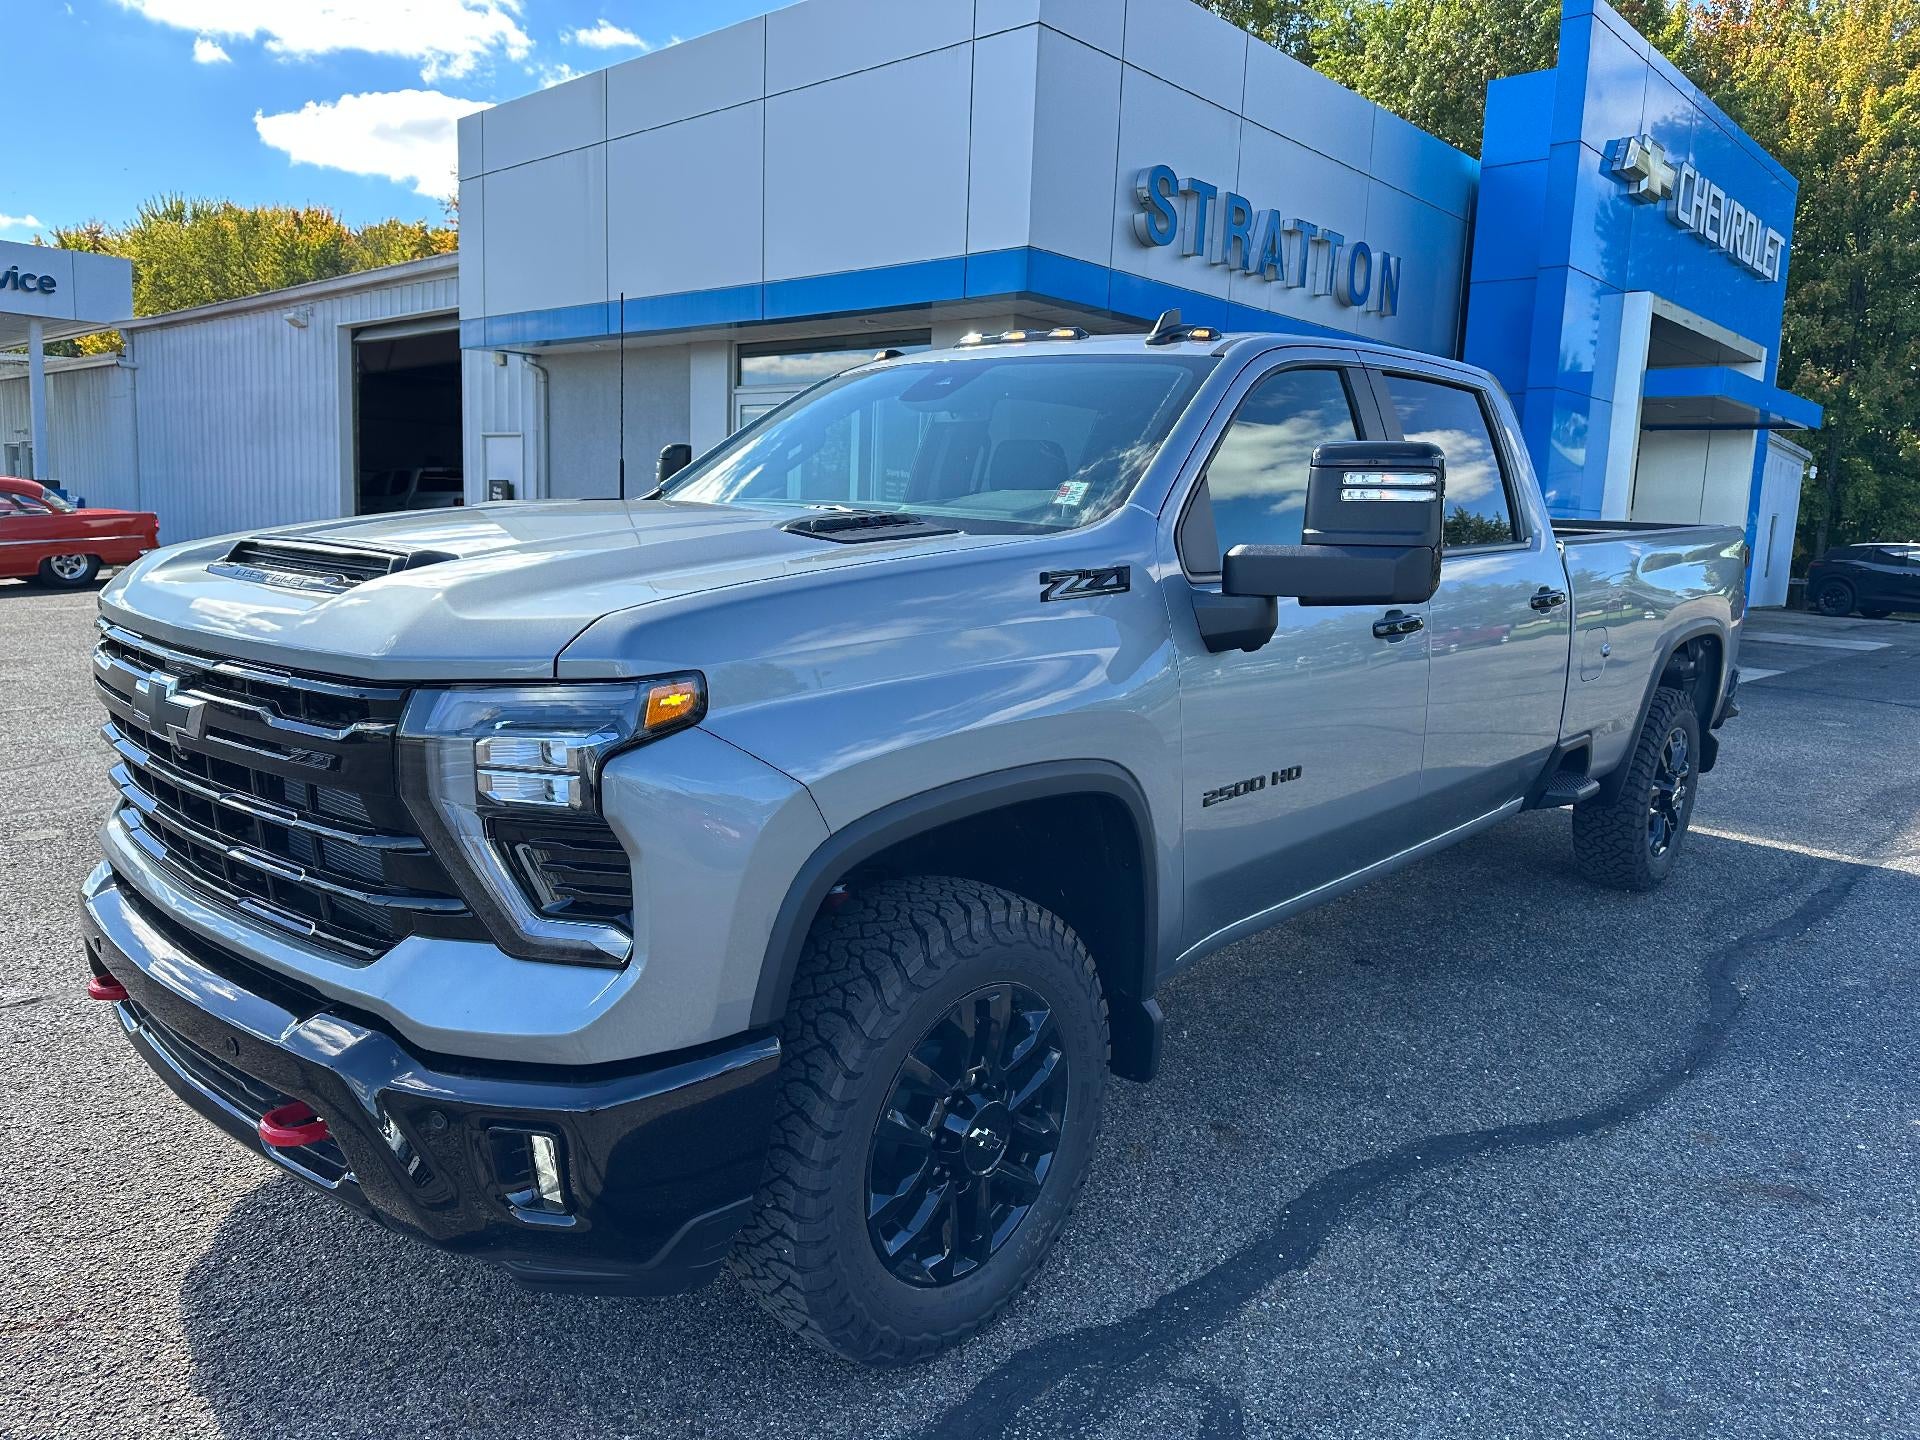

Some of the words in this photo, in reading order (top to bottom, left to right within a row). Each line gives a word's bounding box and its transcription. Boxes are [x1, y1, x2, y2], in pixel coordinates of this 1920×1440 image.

[1133, 164, 1401, 317] STRATTON
[1674, 161, 1786, 282] CHEVROLET
[1039, 565, 1130, 602] Z71
[1202, 775, 1266, 807] 2500
[1271, 765, 1302, 786] HD
